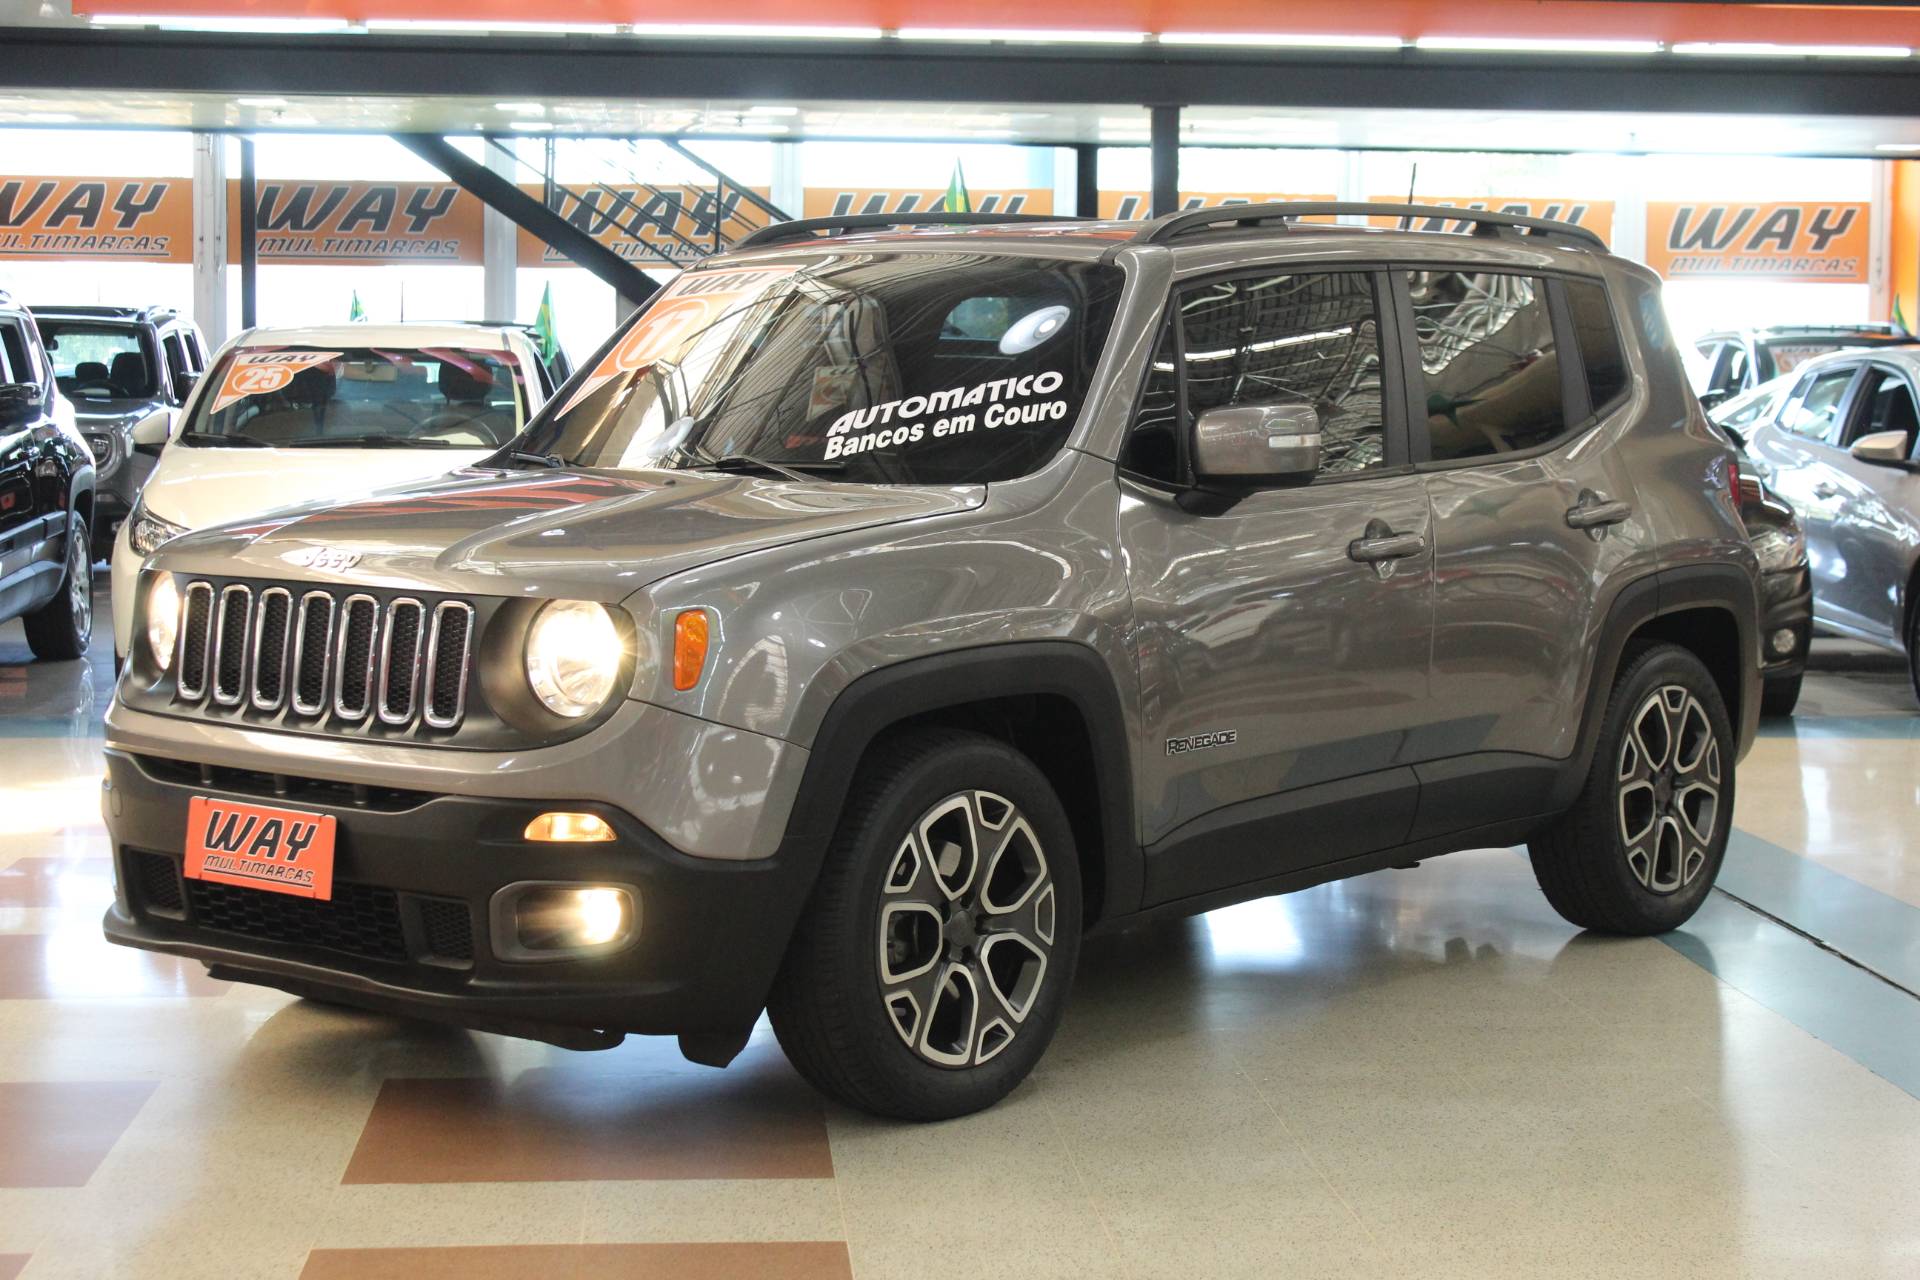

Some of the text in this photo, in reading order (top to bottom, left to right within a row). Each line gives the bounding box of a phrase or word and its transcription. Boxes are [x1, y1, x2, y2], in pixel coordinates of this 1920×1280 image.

[255, 184, 461, 234] WAY
[1667, 205, 1860, 254] WAY
[257, 237, 460, 255] MULTIMARCAS
[1669, 255, 1858, 273] MULTIMARCAS
[676, 272, 770, 297] WAY
[248, 353, 317, 364] WAY
[238, 366, 286, 391] 25
[826, 370, 1064, 438] AUTOMATICO
[823, 399, 1068, 461] Bancos em Couro
[301, 547, 364, 574] Jeep
[1165, 728, 1238, 756] RENEGADE
[204, 808, 320, 864] WAY
[203, 853, 315, 884] MULTIMARCAS
